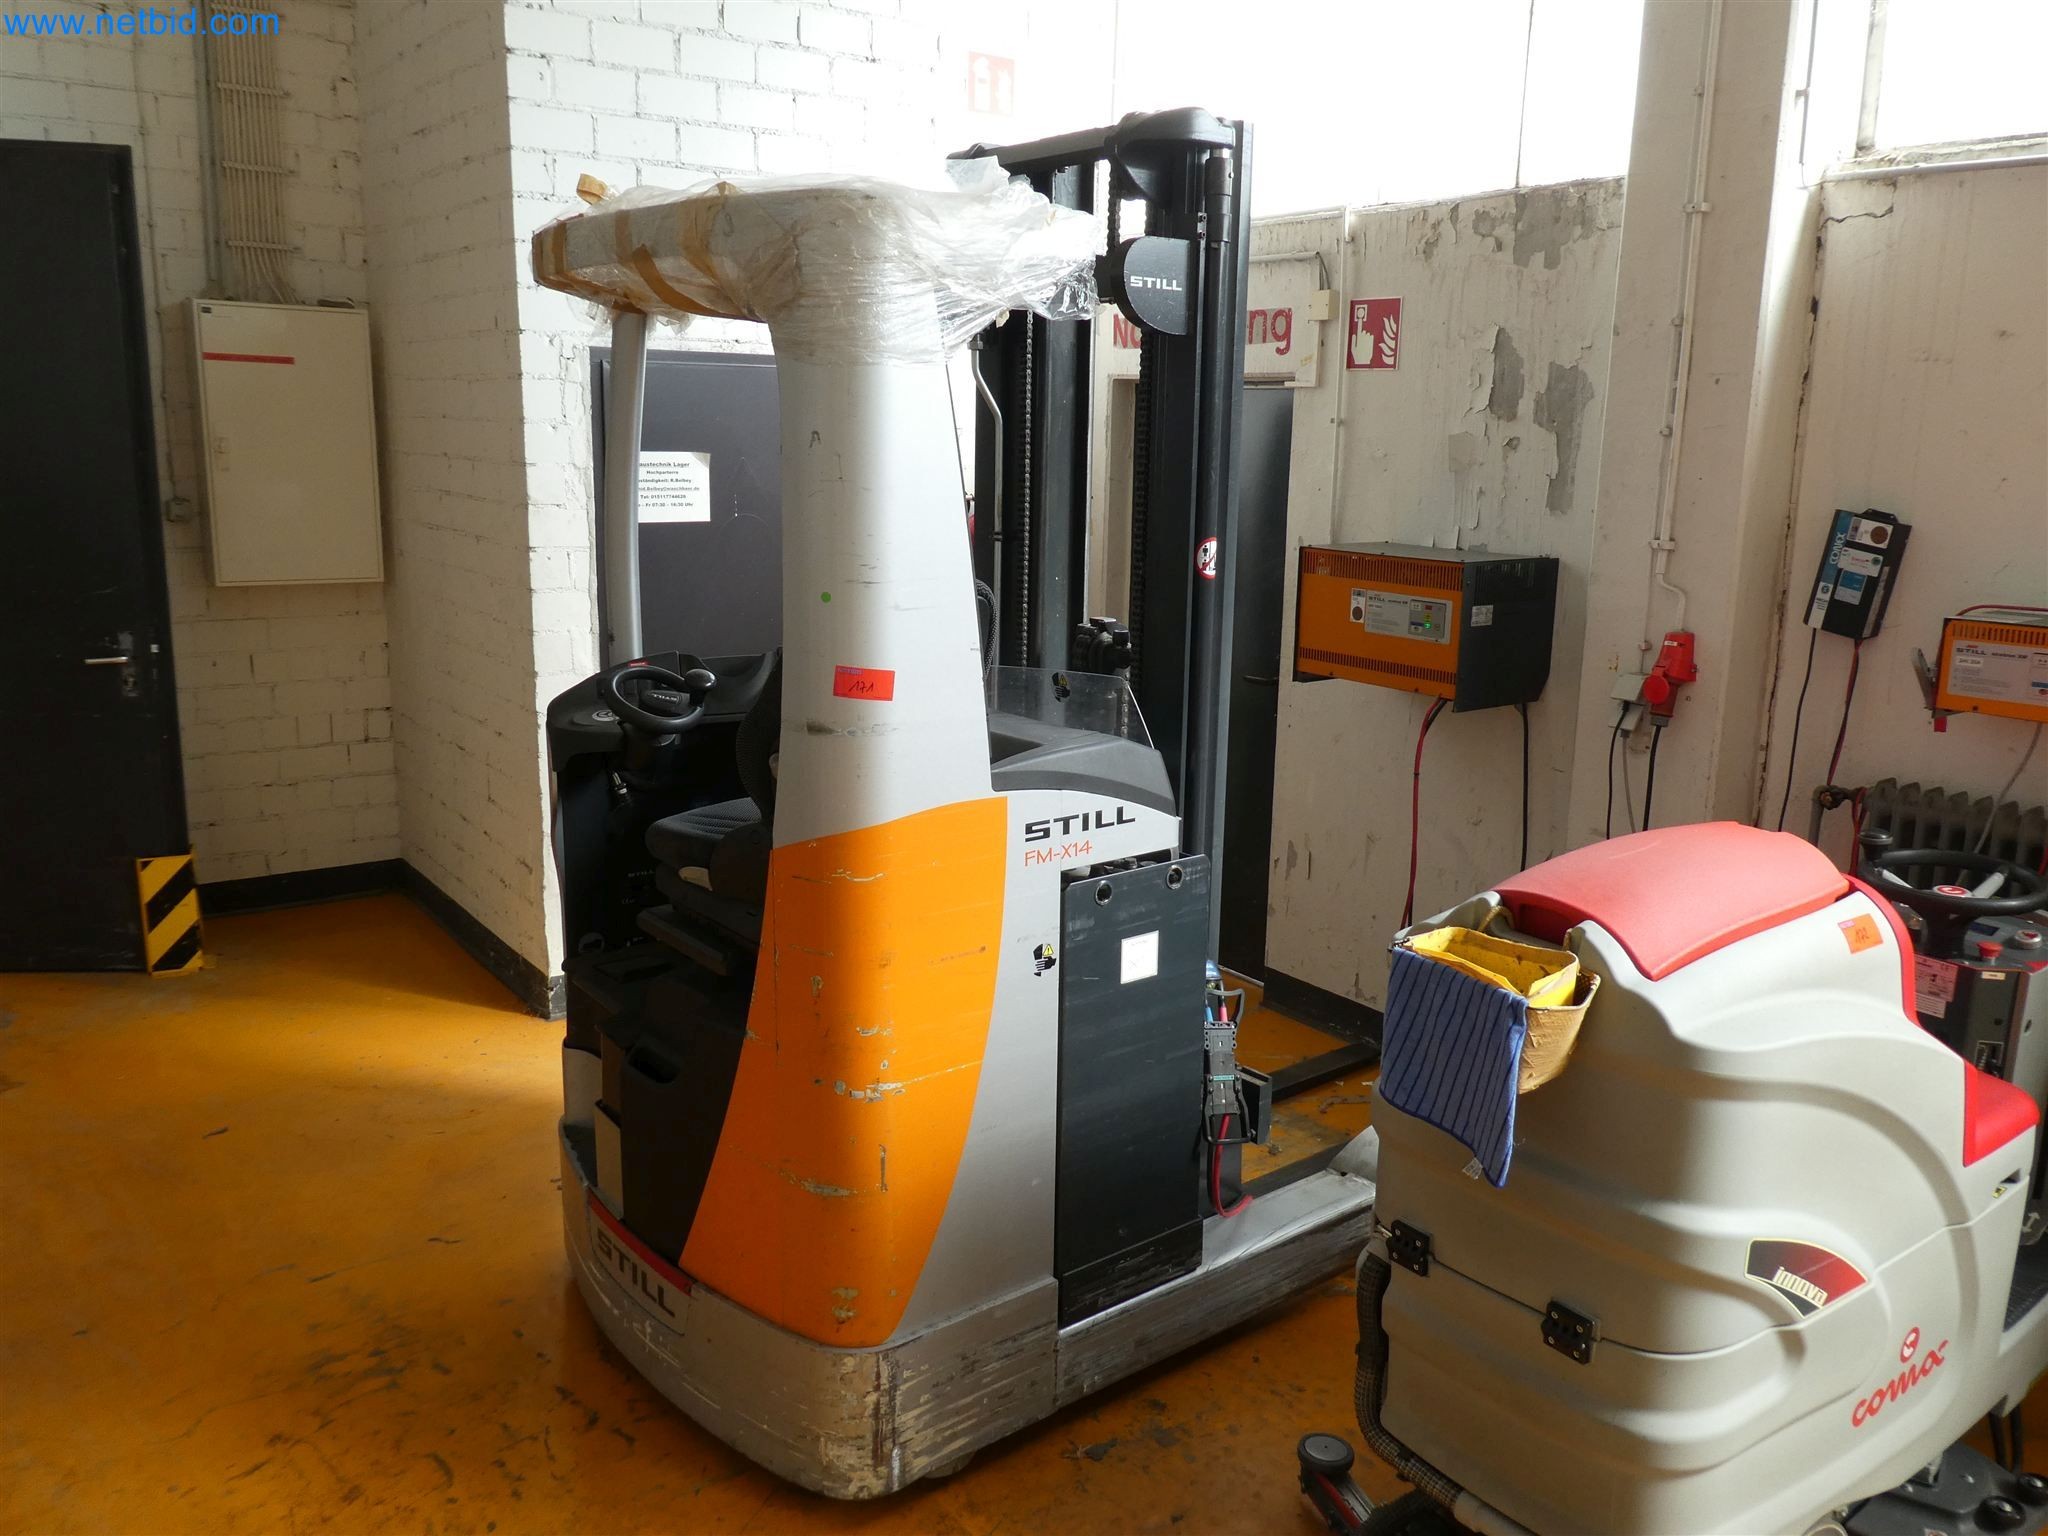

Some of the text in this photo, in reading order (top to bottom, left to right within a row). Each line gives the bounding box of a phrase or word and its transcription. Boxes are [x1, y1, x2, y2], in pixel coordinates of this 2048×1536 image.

[1130, 275, 1183, 292] STILL
[1025, 806, 1136, 843] STILL
[1024, 839, 1093, 868] FM-X14
[598, 1227, 676, 1318] STILL
[1772, 1266, 1828, 1308] innova
